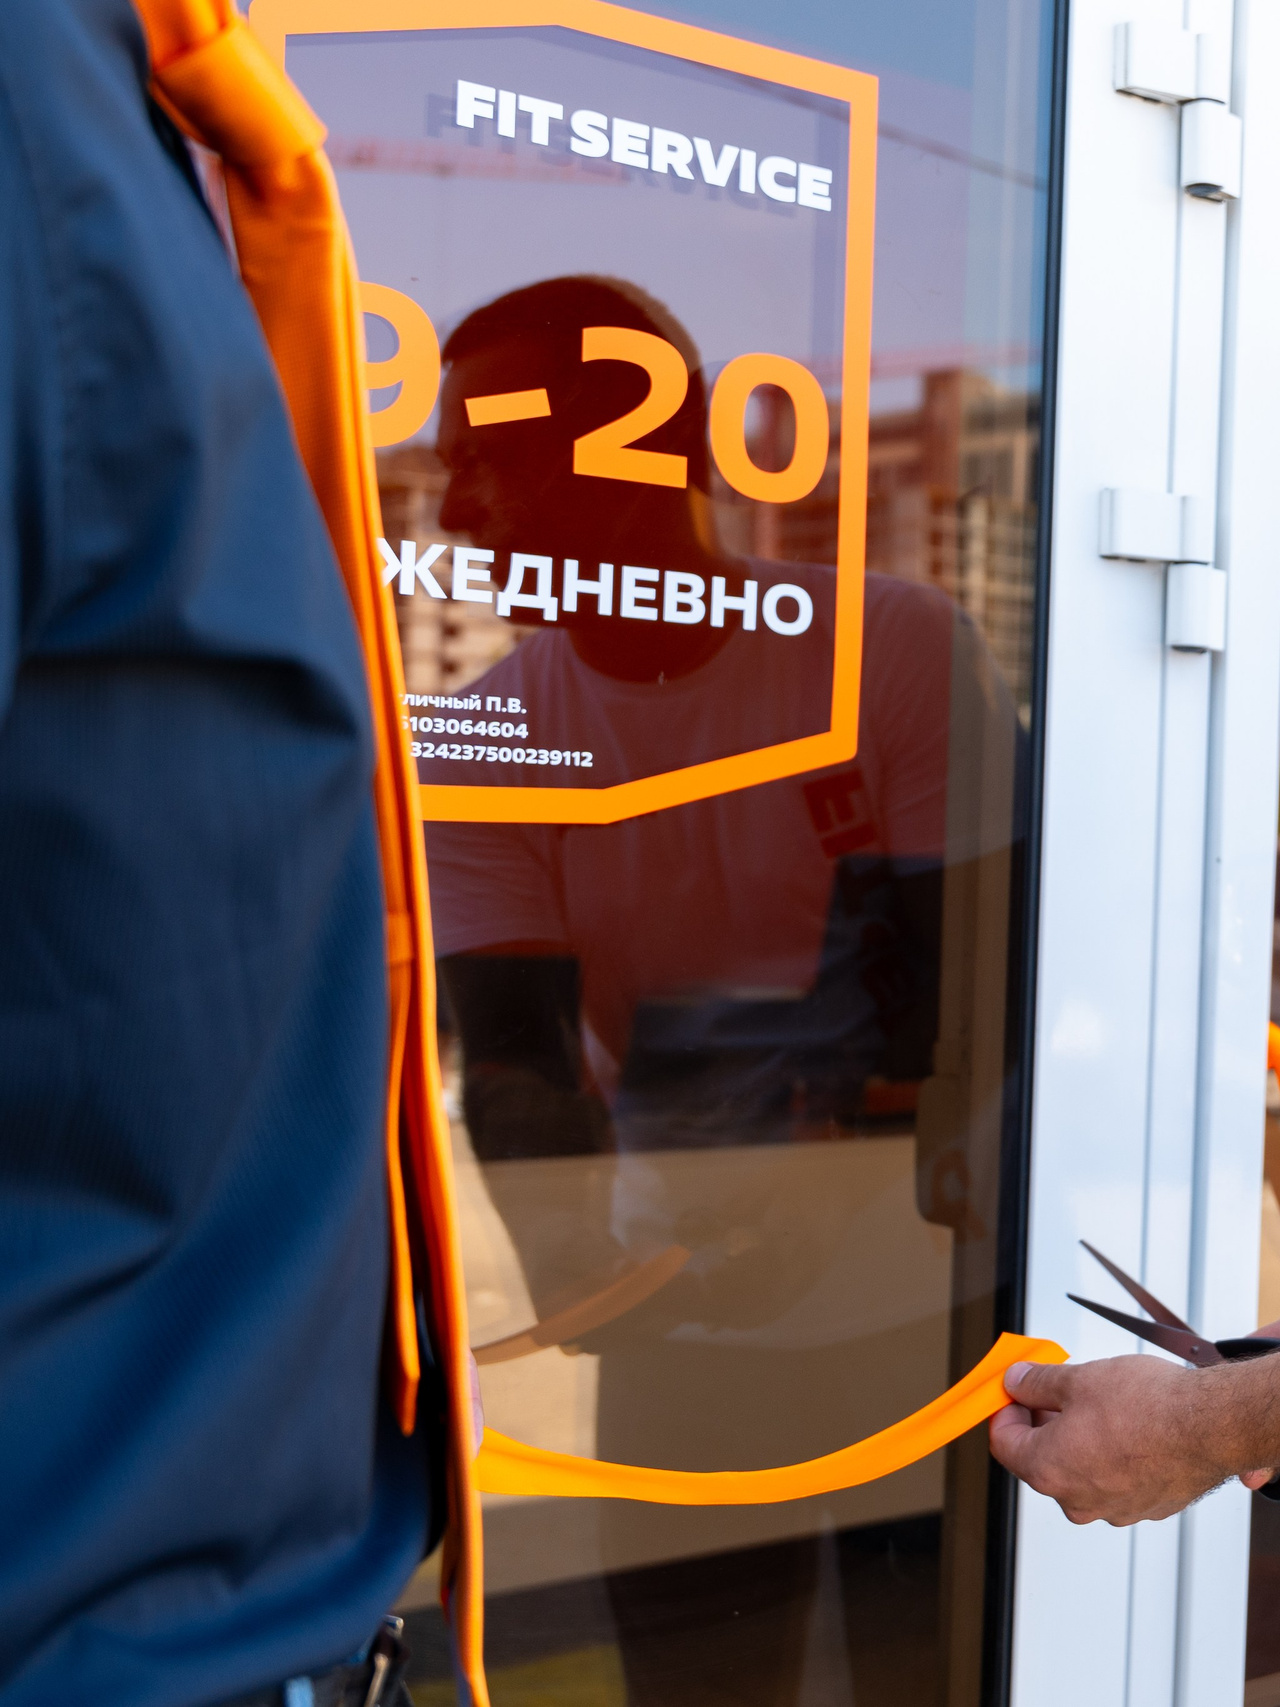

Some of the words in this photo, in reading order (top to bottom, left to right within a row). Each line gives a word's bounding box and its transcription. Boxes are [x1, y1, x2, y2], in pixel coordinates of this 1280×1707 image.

[456, 79, 563, 146] FIT
[570, 109, 833, 212] SERVICE
[376, 537, 814, 637] ЖЕДНЕВНО
[399, 693, 482, 711] личный
[486, 695, 528, 714] П.В.
[410, 741, 594, 768] 324237500239112
